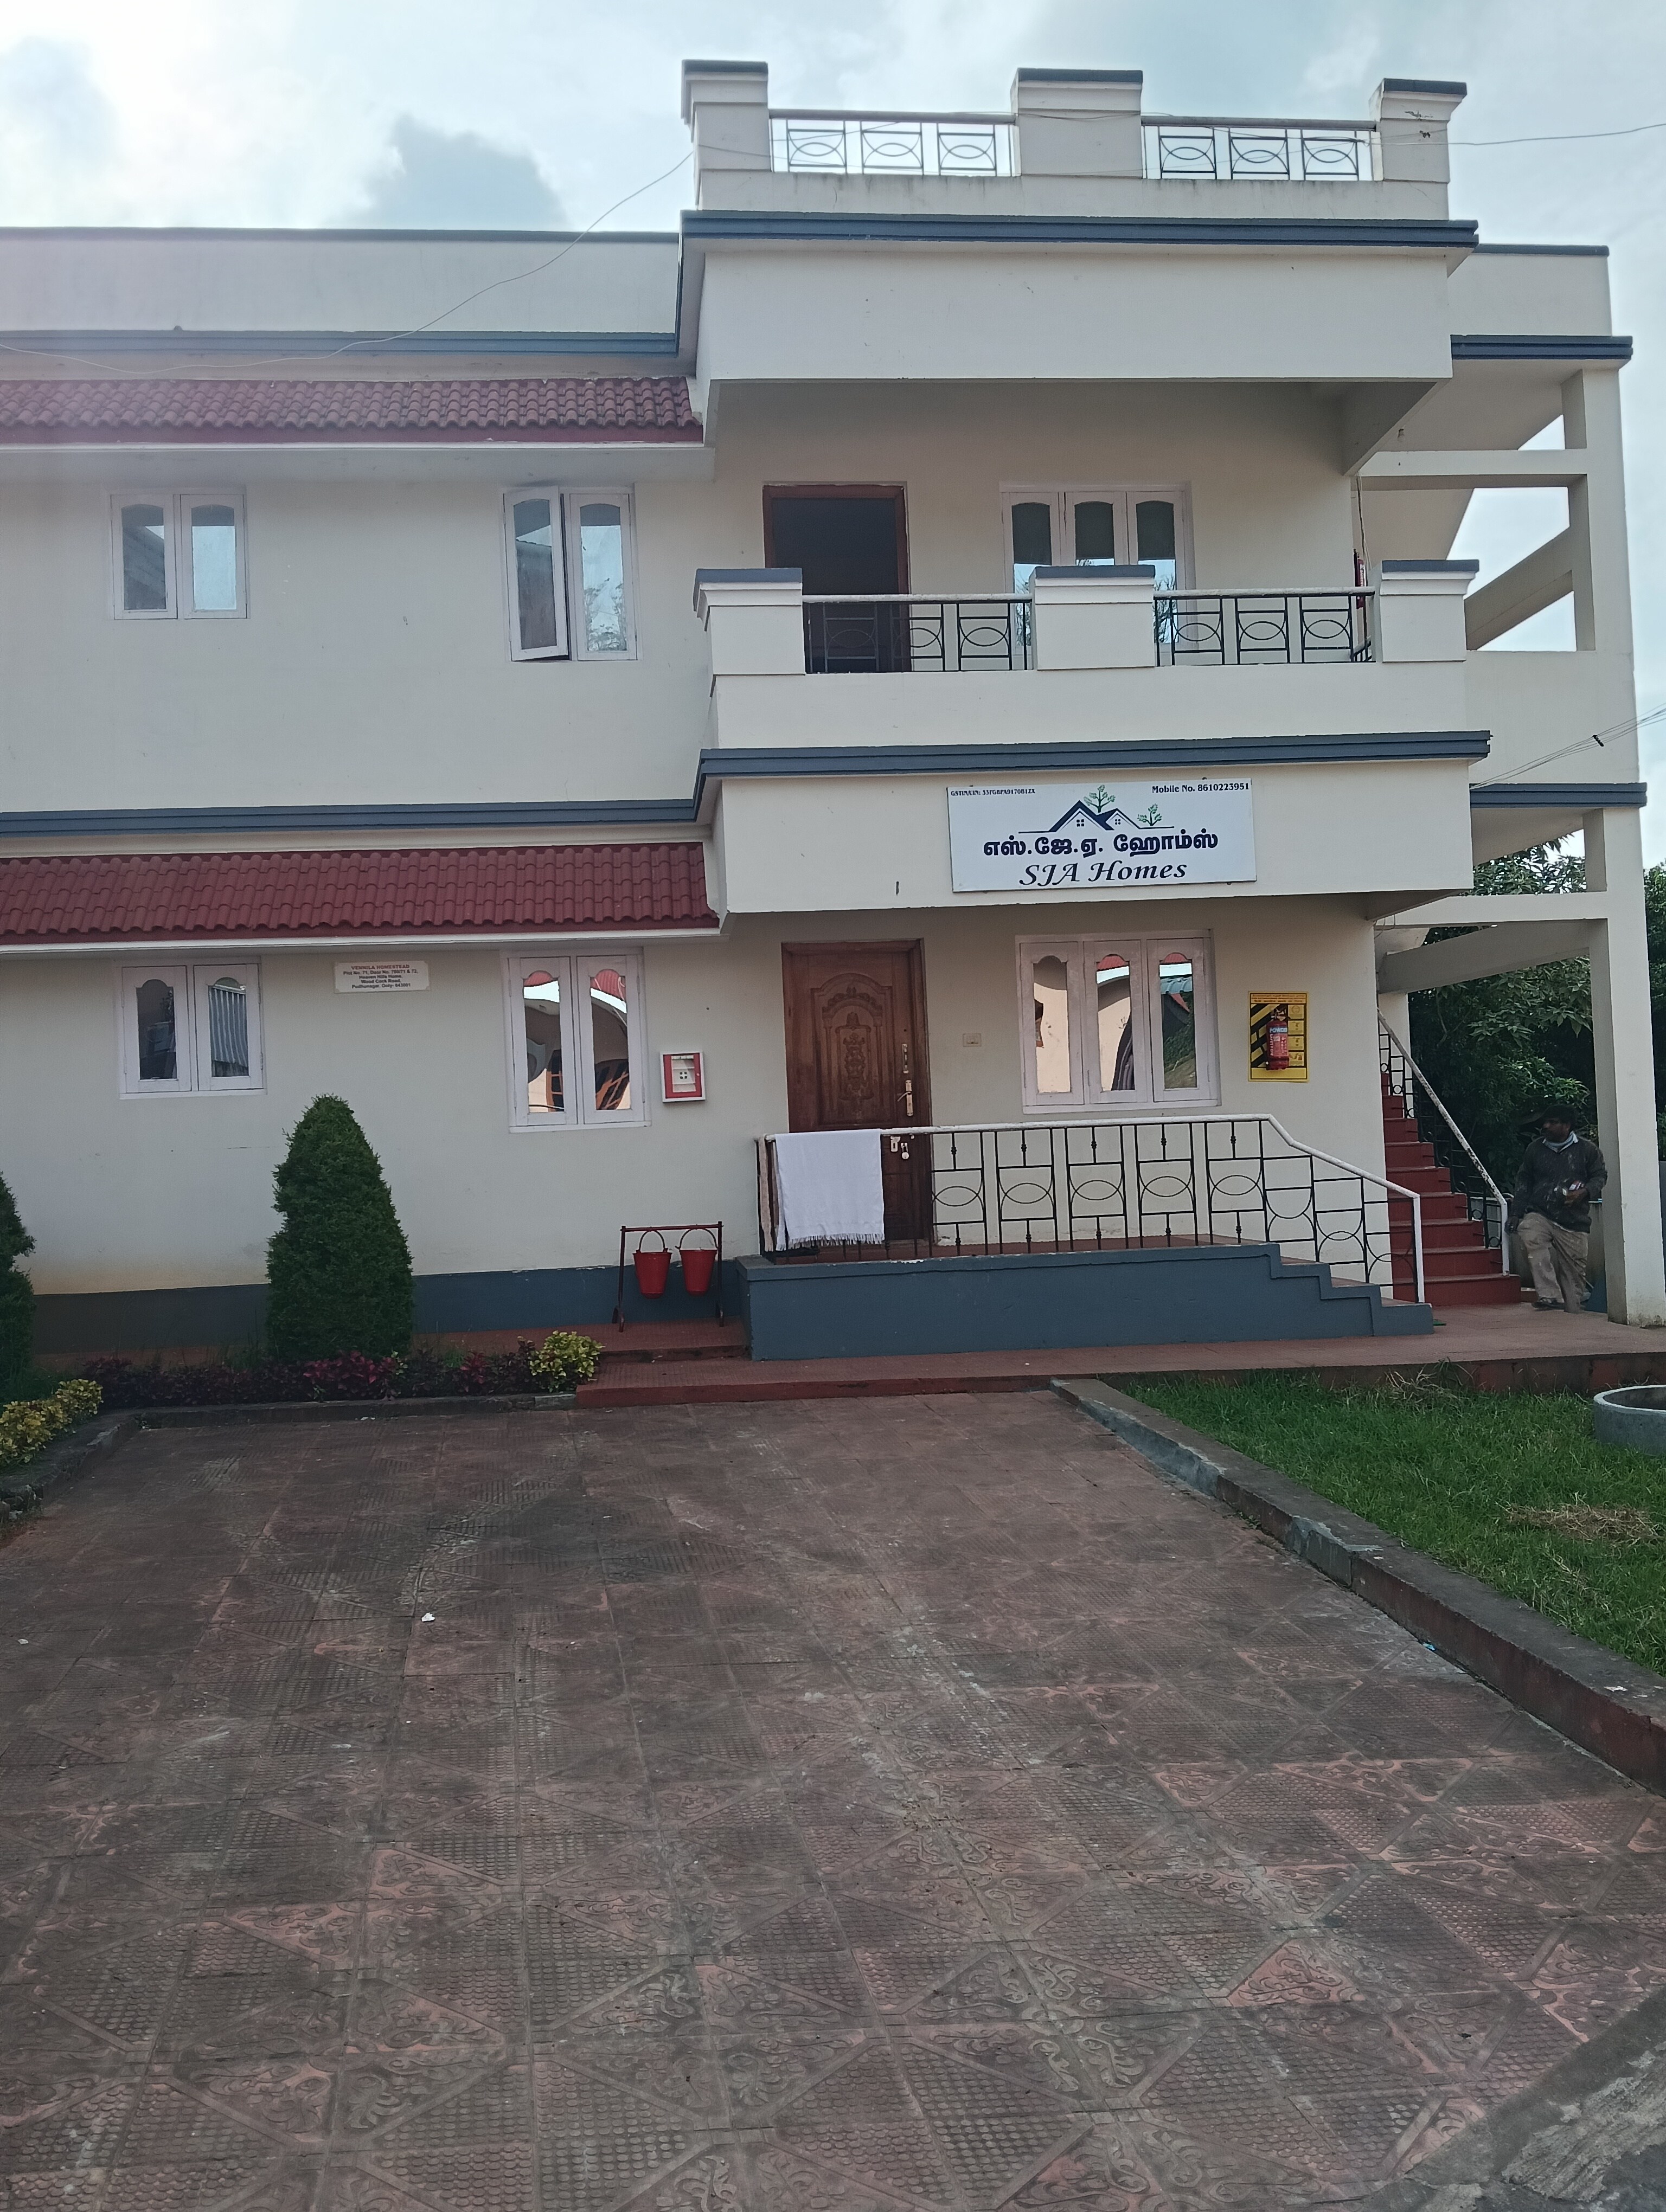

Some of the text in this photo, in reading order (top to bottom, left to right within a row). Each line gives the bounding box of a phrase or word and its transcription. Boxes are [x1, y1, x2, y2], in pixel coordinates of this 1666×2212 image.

[1152, 785, 1180, 793] Mobile
[1197, 783, 1249, 792] 8610223951
[1113, 828, 1219, 857] ஹோம்ஸ்
[1019, 860, 1188, 886] SJA Homes
